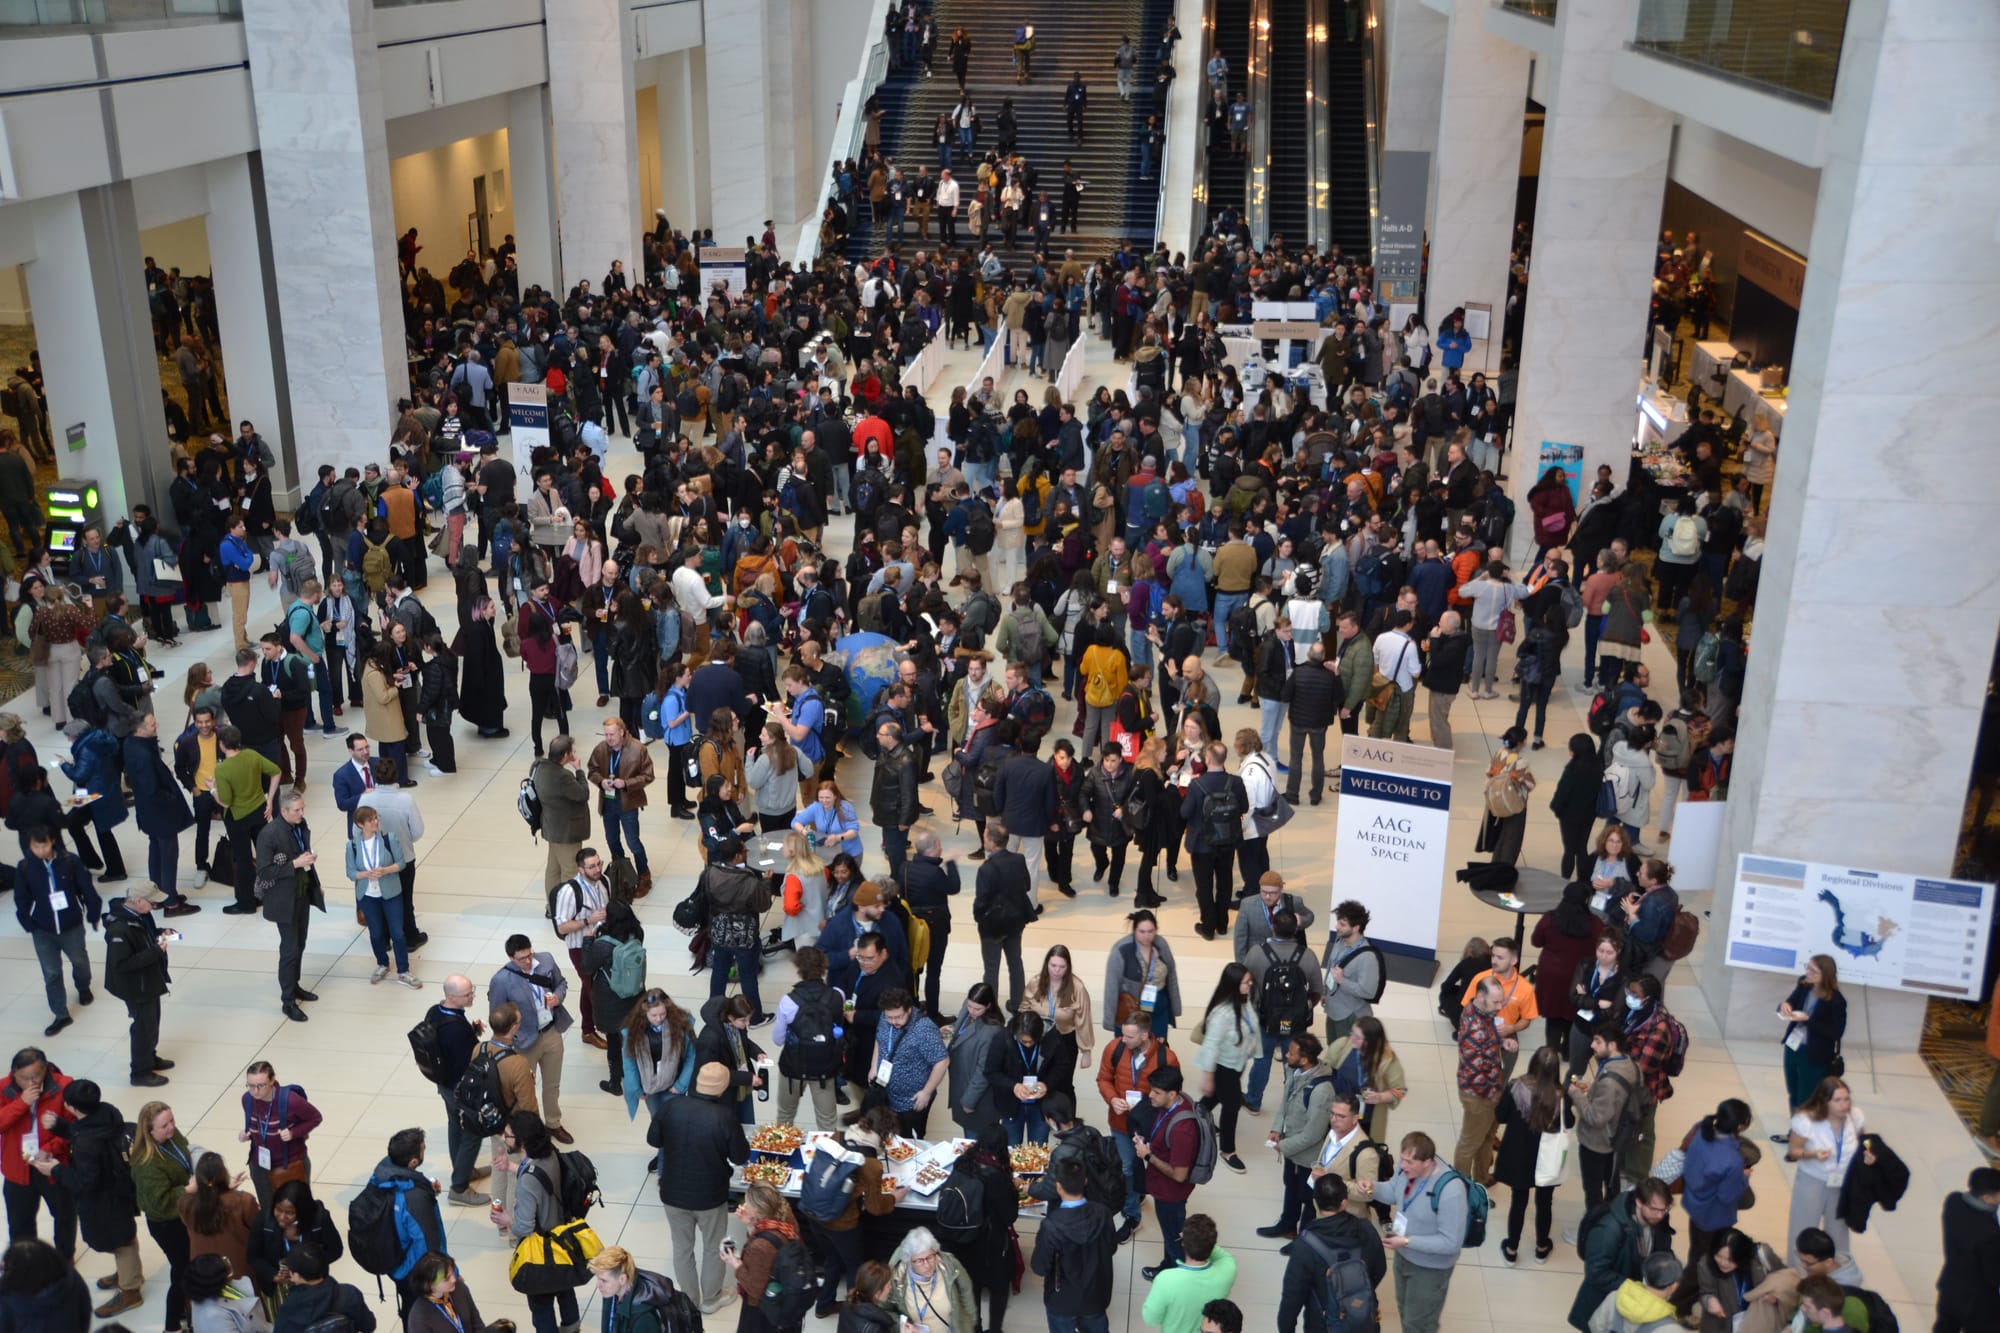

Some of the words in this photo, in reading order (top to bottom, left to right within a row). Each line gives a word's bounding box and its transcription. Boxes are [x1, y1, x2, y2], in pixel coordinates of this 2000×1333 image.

[1381, 224, 1398, 232] Halls
[511, 408, 545, 417] WELCOME
[1362, 747, 1394, 763] AAG
[1350, 776, 1418, 798] WELCOME
[1421, 787, 1442, 801] TO
[1372, 815, 1412, 834] AAG
[1356, 829, 1426, 850] MERIDIAN
[1371, 846, 1409, 862] SPACE
[1821, 873, 1860, 886] Regional
[1862, 878, 1904, 892] Divisions
